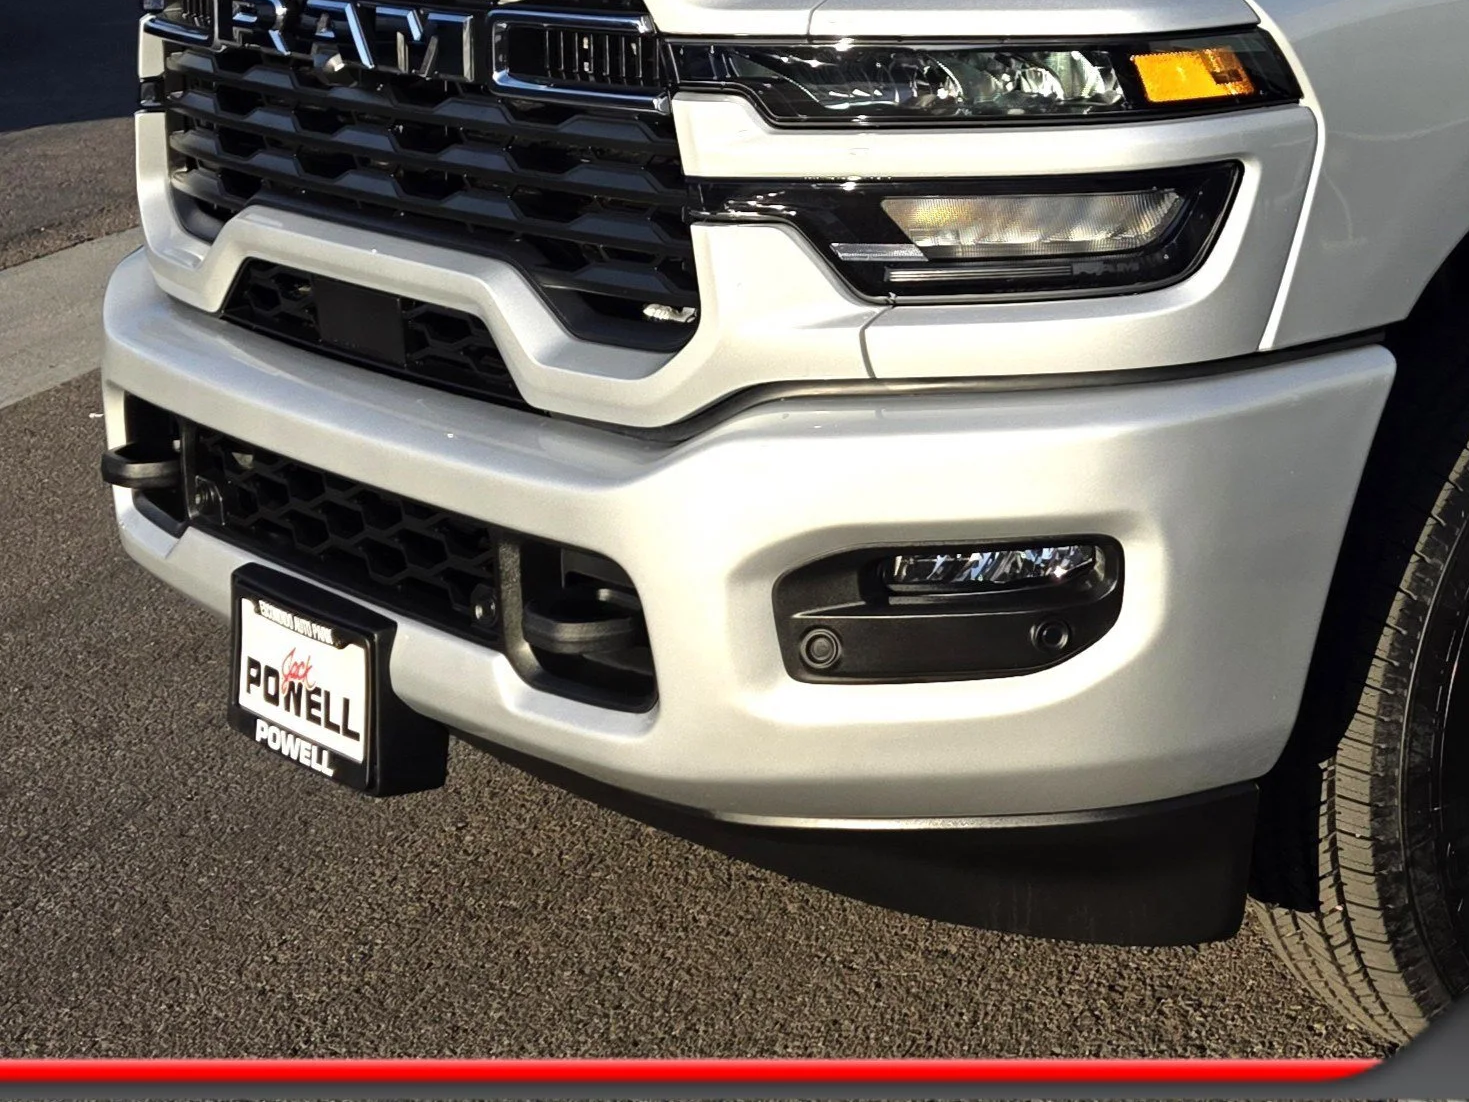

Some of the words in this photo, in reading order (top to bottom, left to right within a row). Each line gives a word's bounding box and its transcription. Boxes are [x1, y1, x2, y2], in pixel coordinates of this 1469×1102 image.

[246, 655, 361, 742] POWELL
[281, 646, 316, 695] Jack
[255, 718, 335, 778] POWELL
